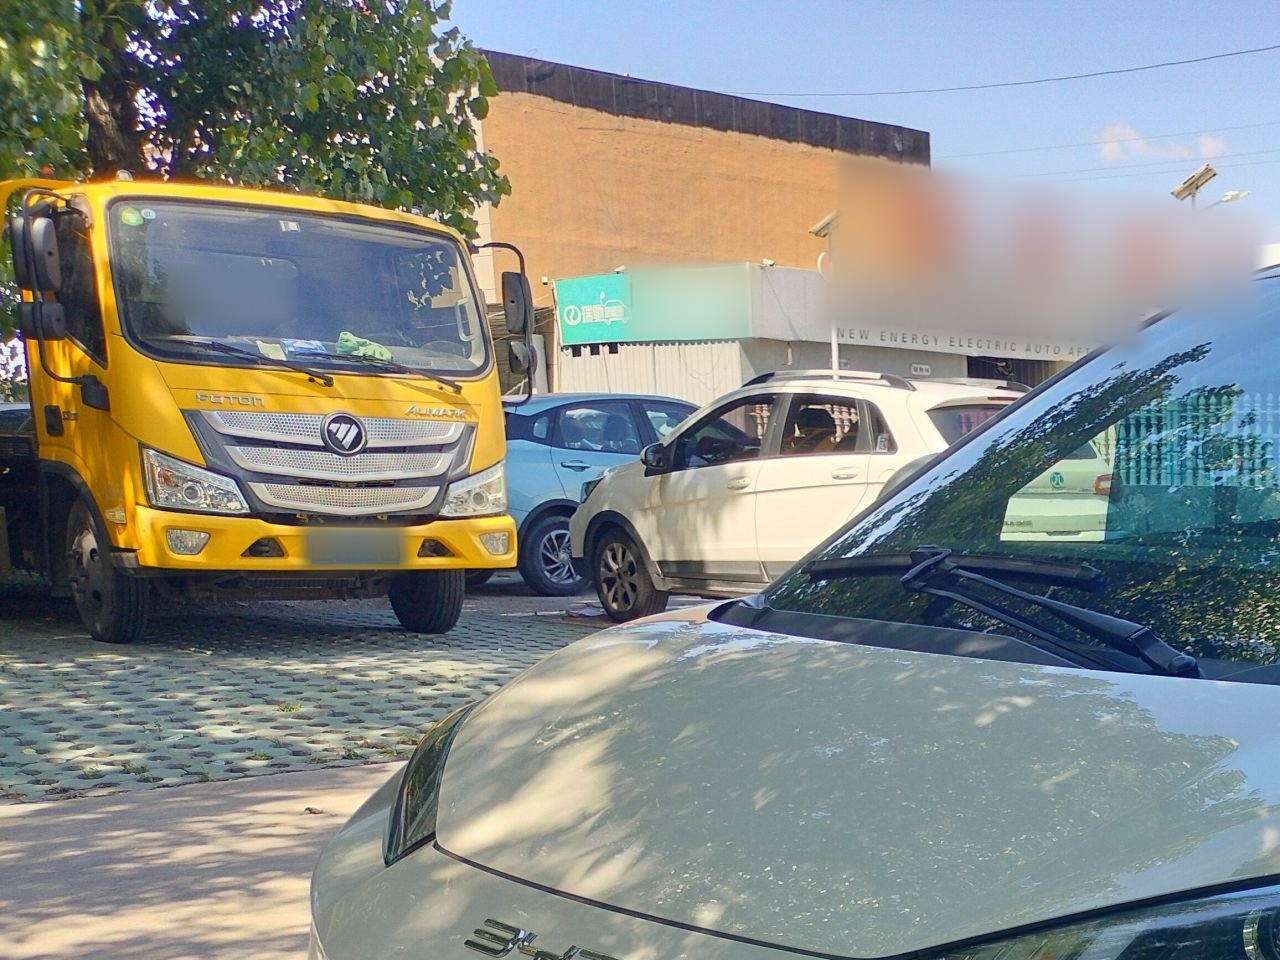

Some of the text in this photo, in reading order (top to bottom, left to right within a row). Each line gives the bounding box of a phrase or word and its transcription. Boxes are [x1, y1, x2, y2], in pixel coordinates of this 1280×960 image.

[837, 327, 870, 341] NEW
[880, 331, 940, 346] ENERGY
[949, 336, 1017, 352] ELECTRIC
[1025, 343, 1061, 355] AUTO
[196, 392, 265, 407] FOTON
